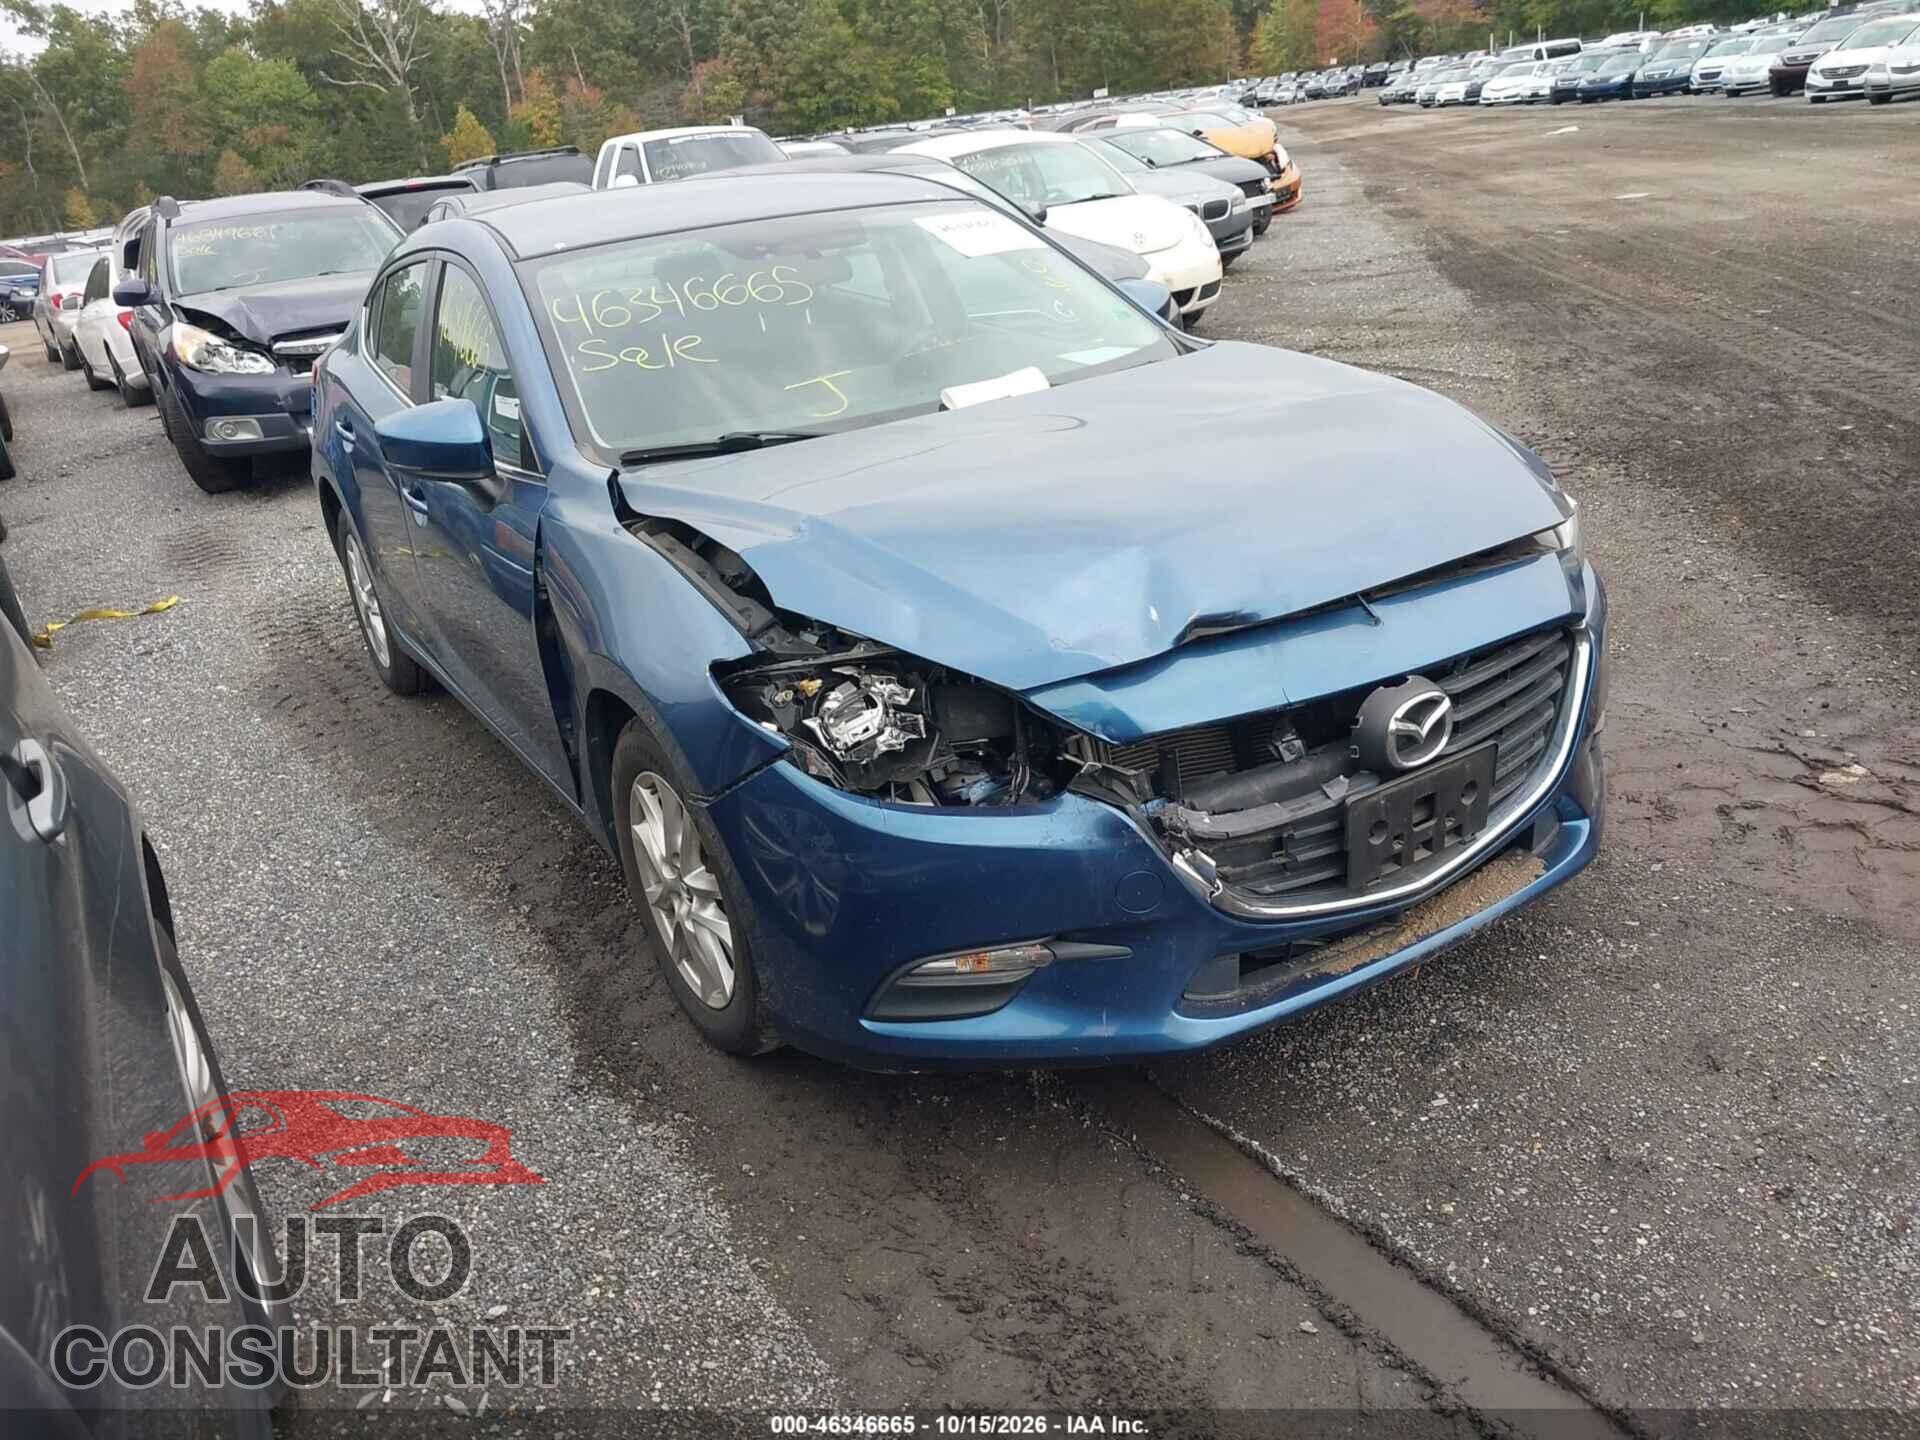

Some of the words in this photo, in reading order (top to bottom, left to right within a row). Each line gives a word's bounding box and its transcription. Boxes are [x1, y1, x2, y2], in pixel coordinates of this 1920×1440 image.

[552, 265, 813, 335] 46346665
[578, 333, 719, 371] Sale
[783, 369, 853, 418] J
